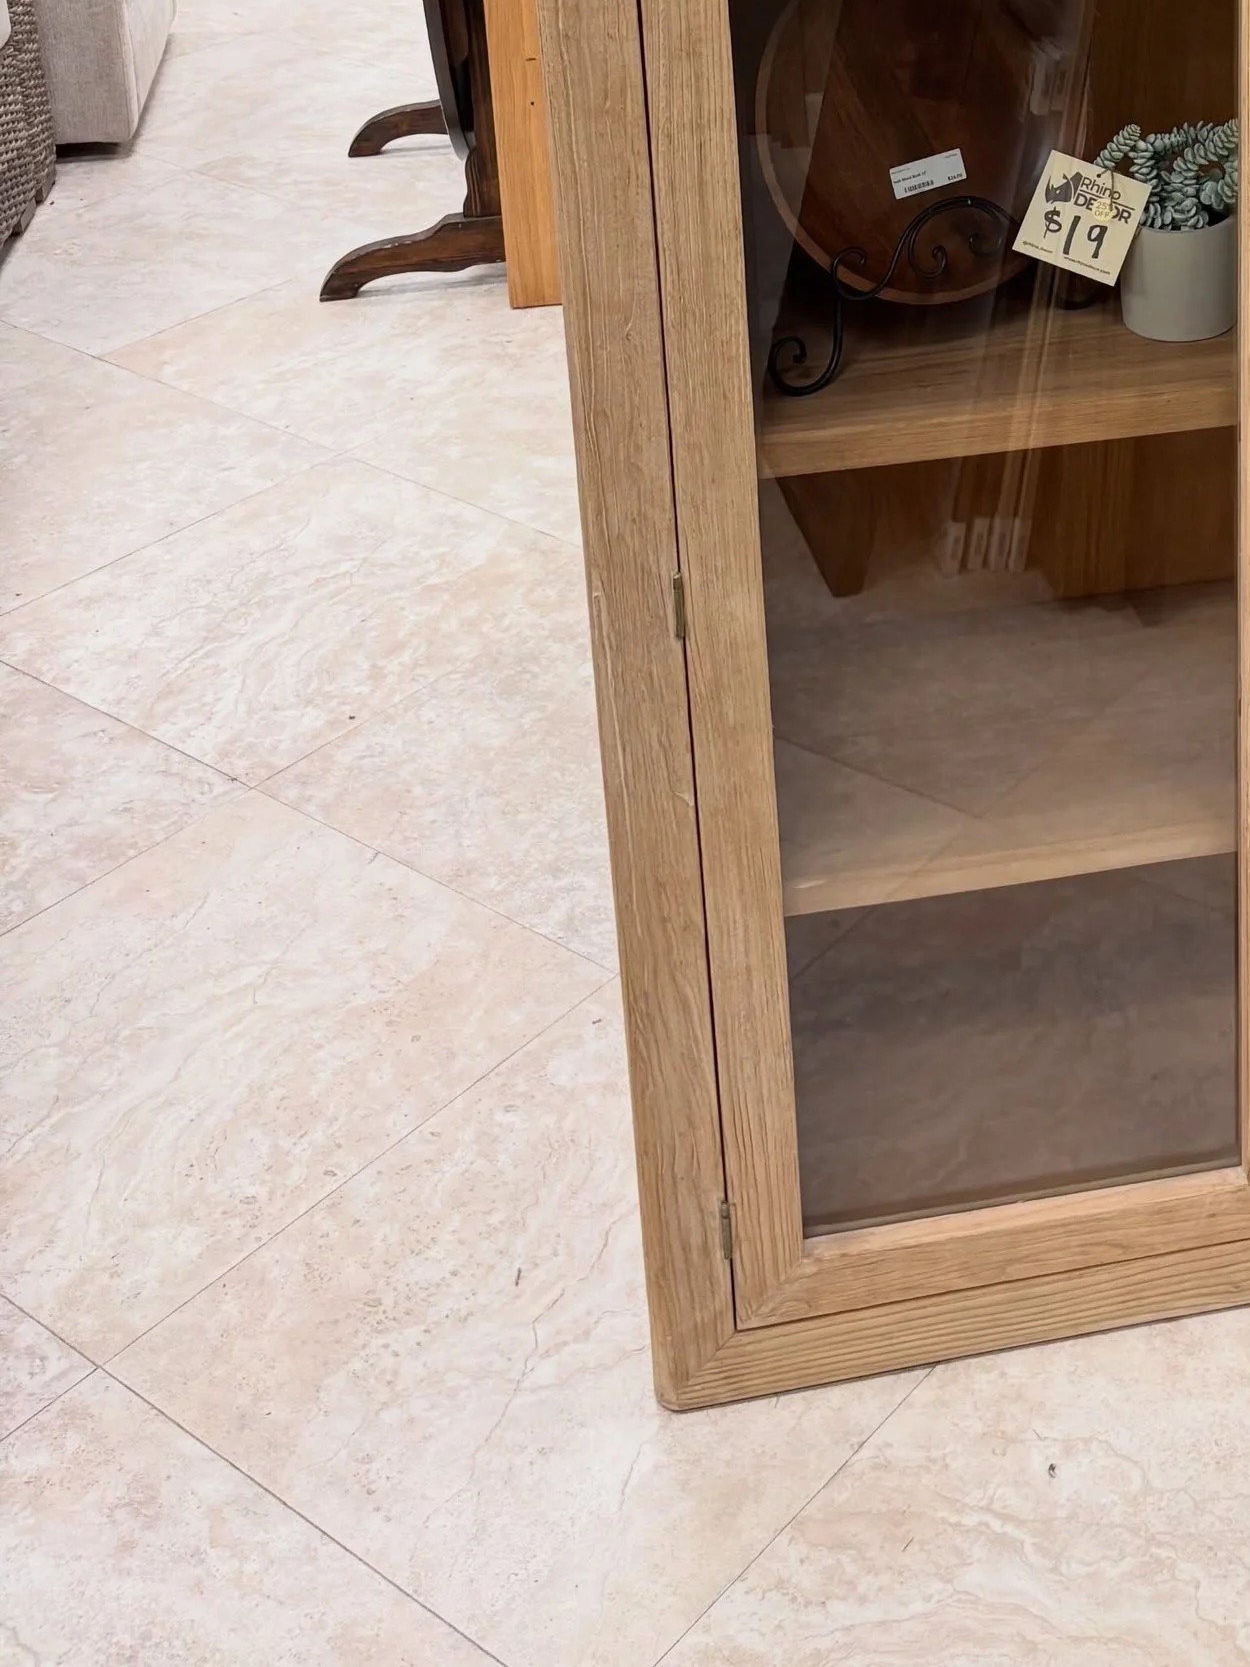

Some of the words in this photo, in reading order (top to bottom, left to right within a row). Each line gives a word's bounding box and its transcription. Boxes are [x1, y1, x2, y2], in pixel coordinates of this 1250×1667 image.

[1080, 177, 1121, 201] Rhino
[1074, 193, 1132, 224] DEOR
[1043, 206, 1108, 259] $19
